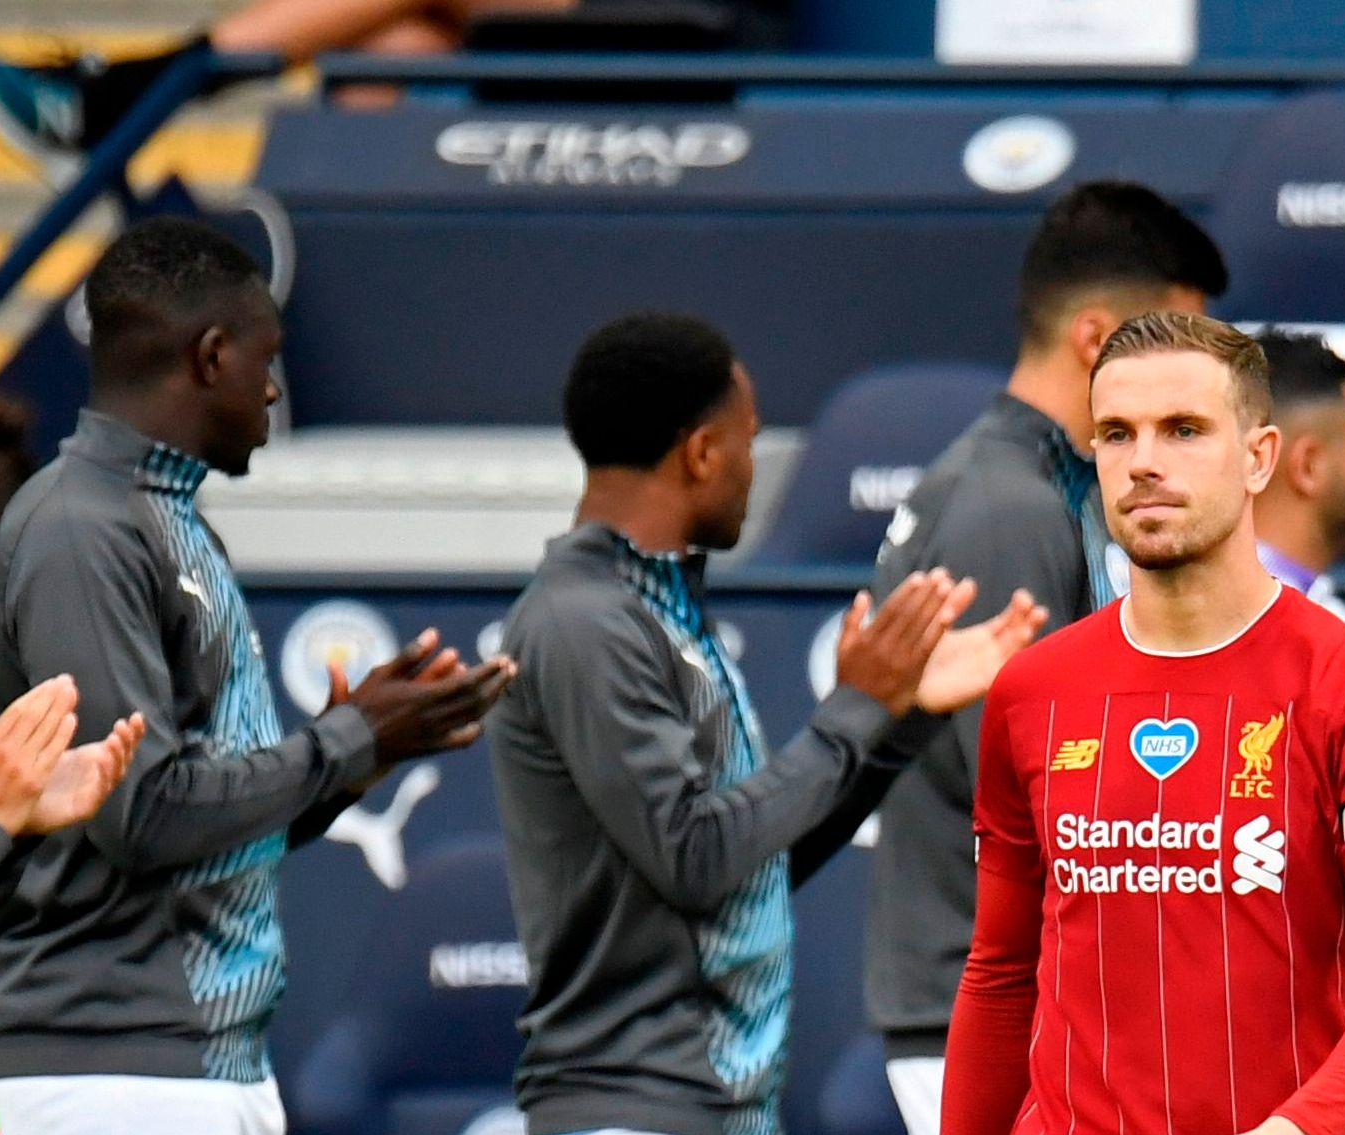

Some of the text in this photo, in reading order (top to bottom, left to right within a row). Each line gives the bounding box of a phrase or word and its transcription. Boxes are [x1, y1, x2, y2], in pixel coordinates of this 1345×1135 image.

[1144, 738, 1184, 754] NHS
[1056, 812, 1222, 851] Standard
[1054, 858, 1223, 894] Chartered
